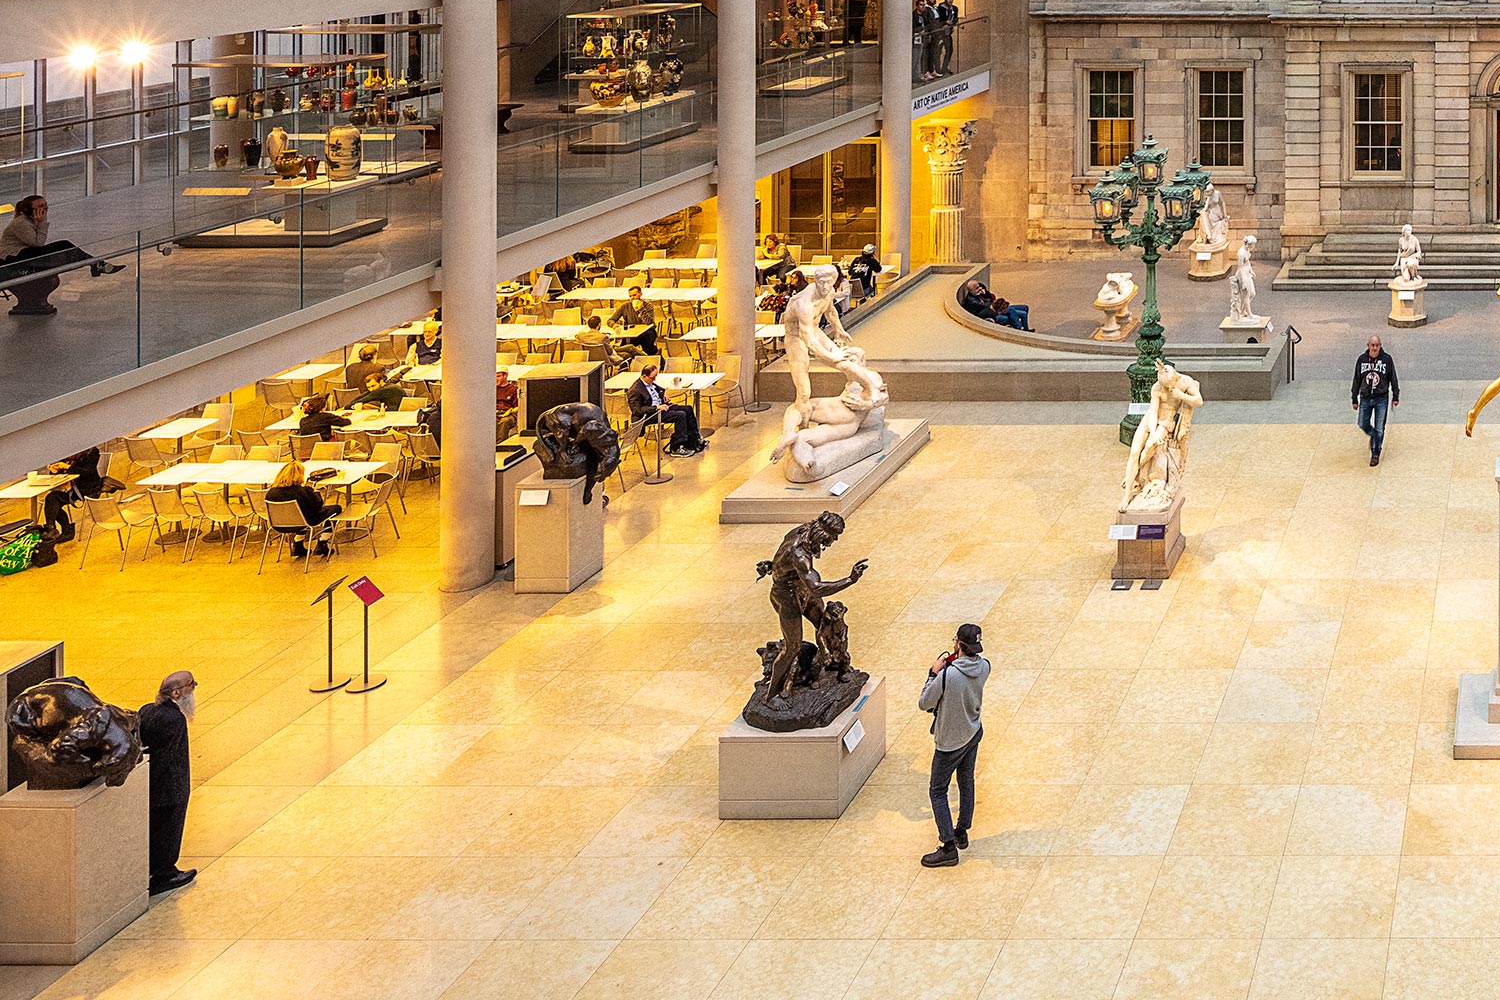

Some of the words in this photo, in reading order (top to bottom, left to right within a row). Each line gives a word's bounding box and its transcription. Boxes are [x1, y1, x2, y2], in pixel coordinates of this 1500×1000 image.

[913, 98, 923, 110] ART
[924, 96, 930, 106] OF
[931, 89, 948, 103] NATIVE
[948, 81, 969, 97] AMERICA
[4, 546, 21, 557] of
